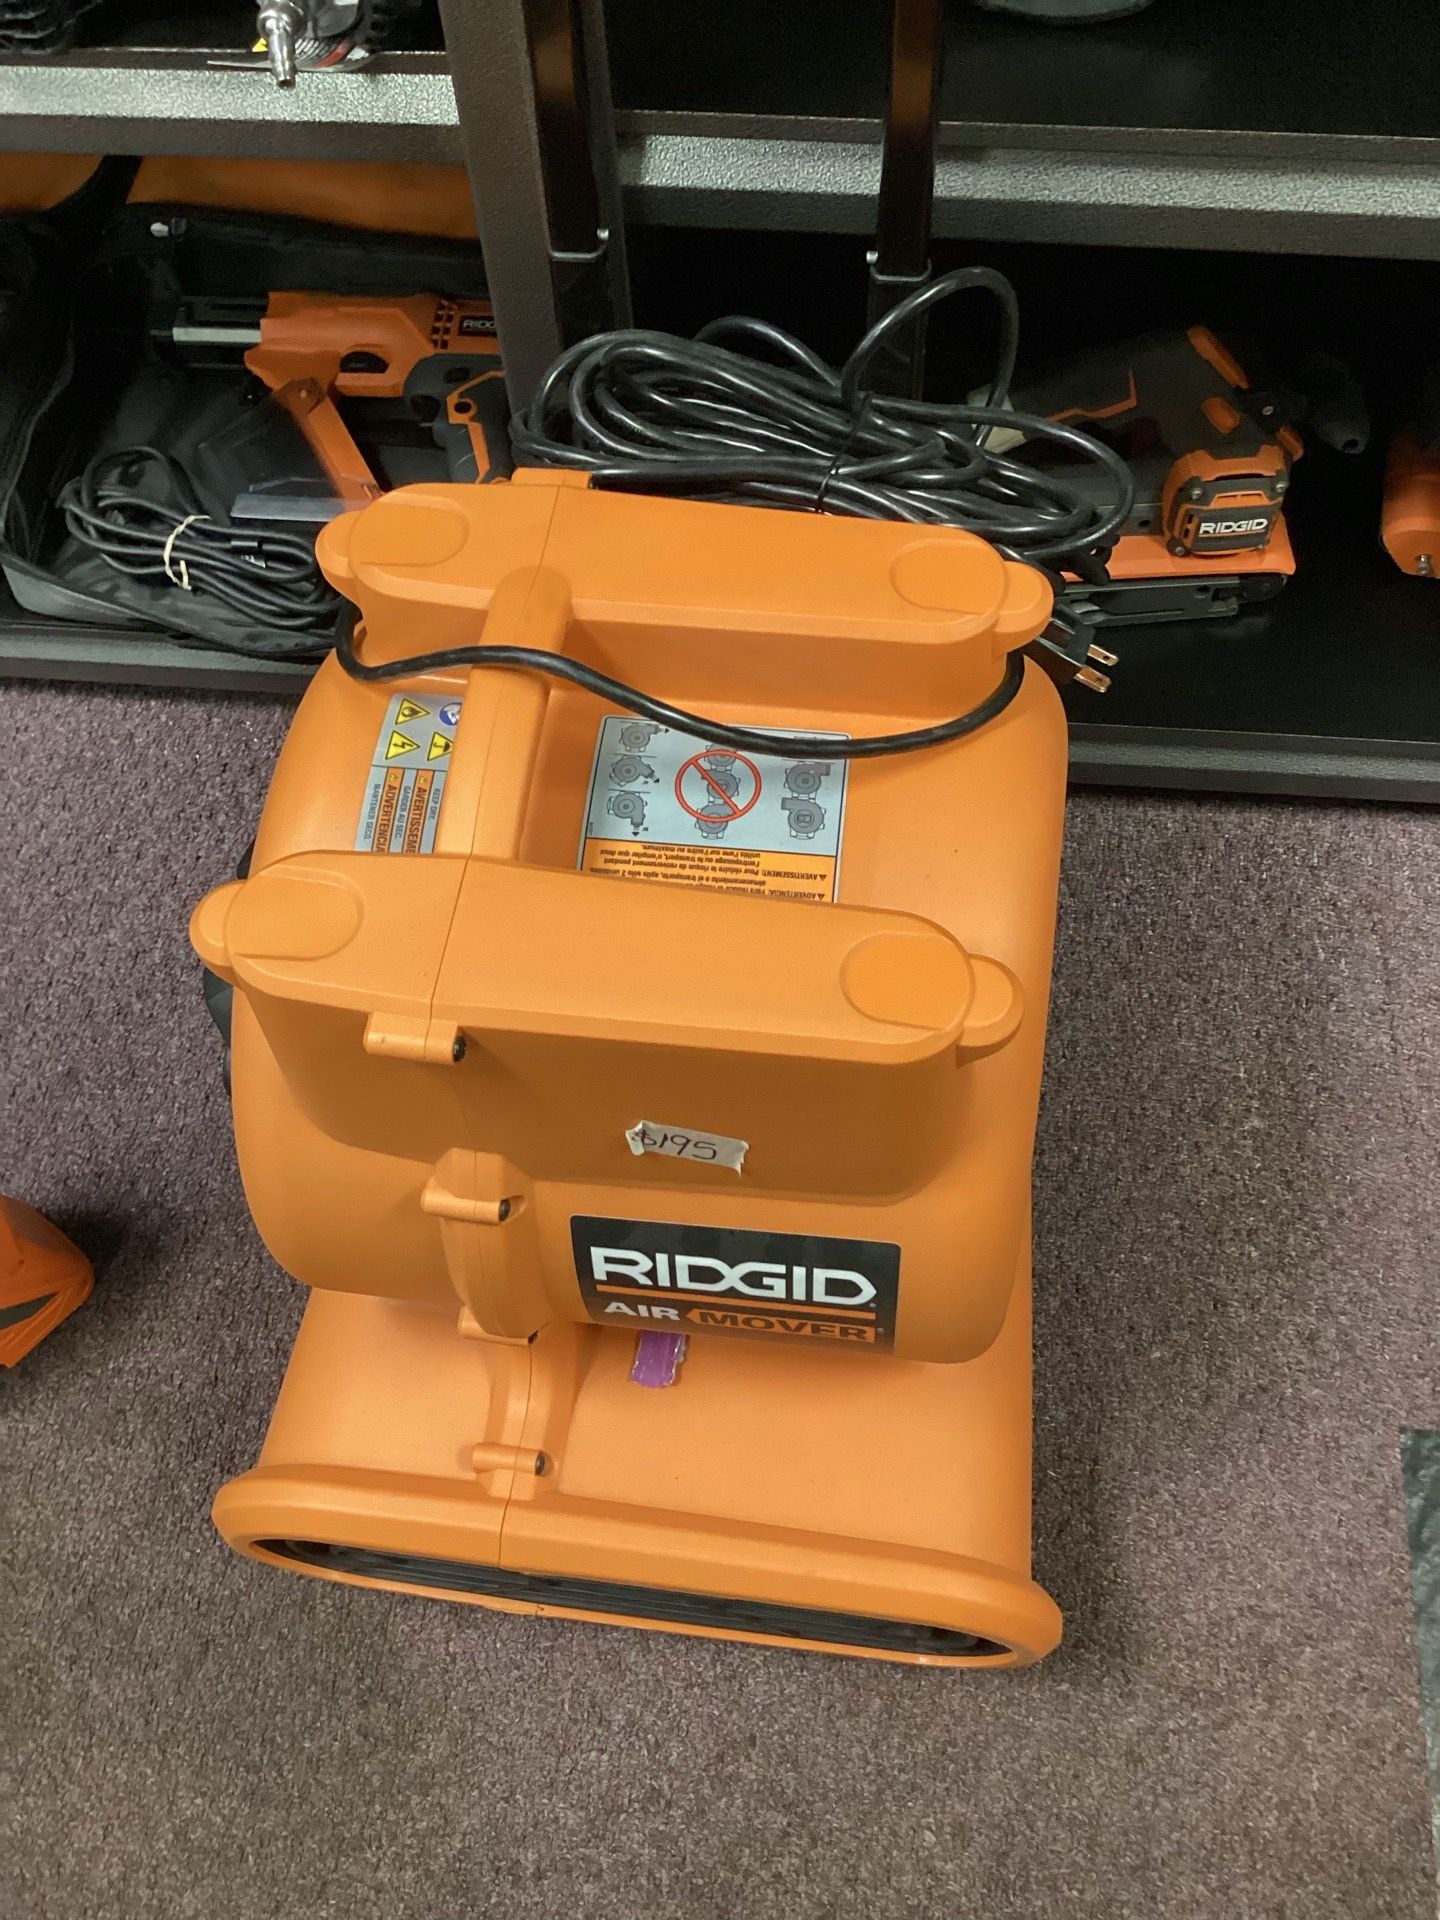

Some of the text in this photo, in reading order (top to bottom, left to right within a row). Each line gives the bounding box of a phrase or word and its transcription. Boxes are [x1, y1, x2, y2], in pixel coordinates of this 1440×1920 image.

[1199, 518, 1269, 534] RIDGID
[431, 788, 441, 806] KEEP
[398, 813, 406, 824] AU
[617, 849, 630, 857] que
[697, 855, 704, 863] le
[621, 869, 626, 877] 2
[711, 864, 717, 872] le
[743, 868, 759, 876] Pour
[631, 1128, 718, 1161] $195
[590, 1246, 877, 1306] RIDGID
[603, 1301, 869, 1341] AIR MOVER
